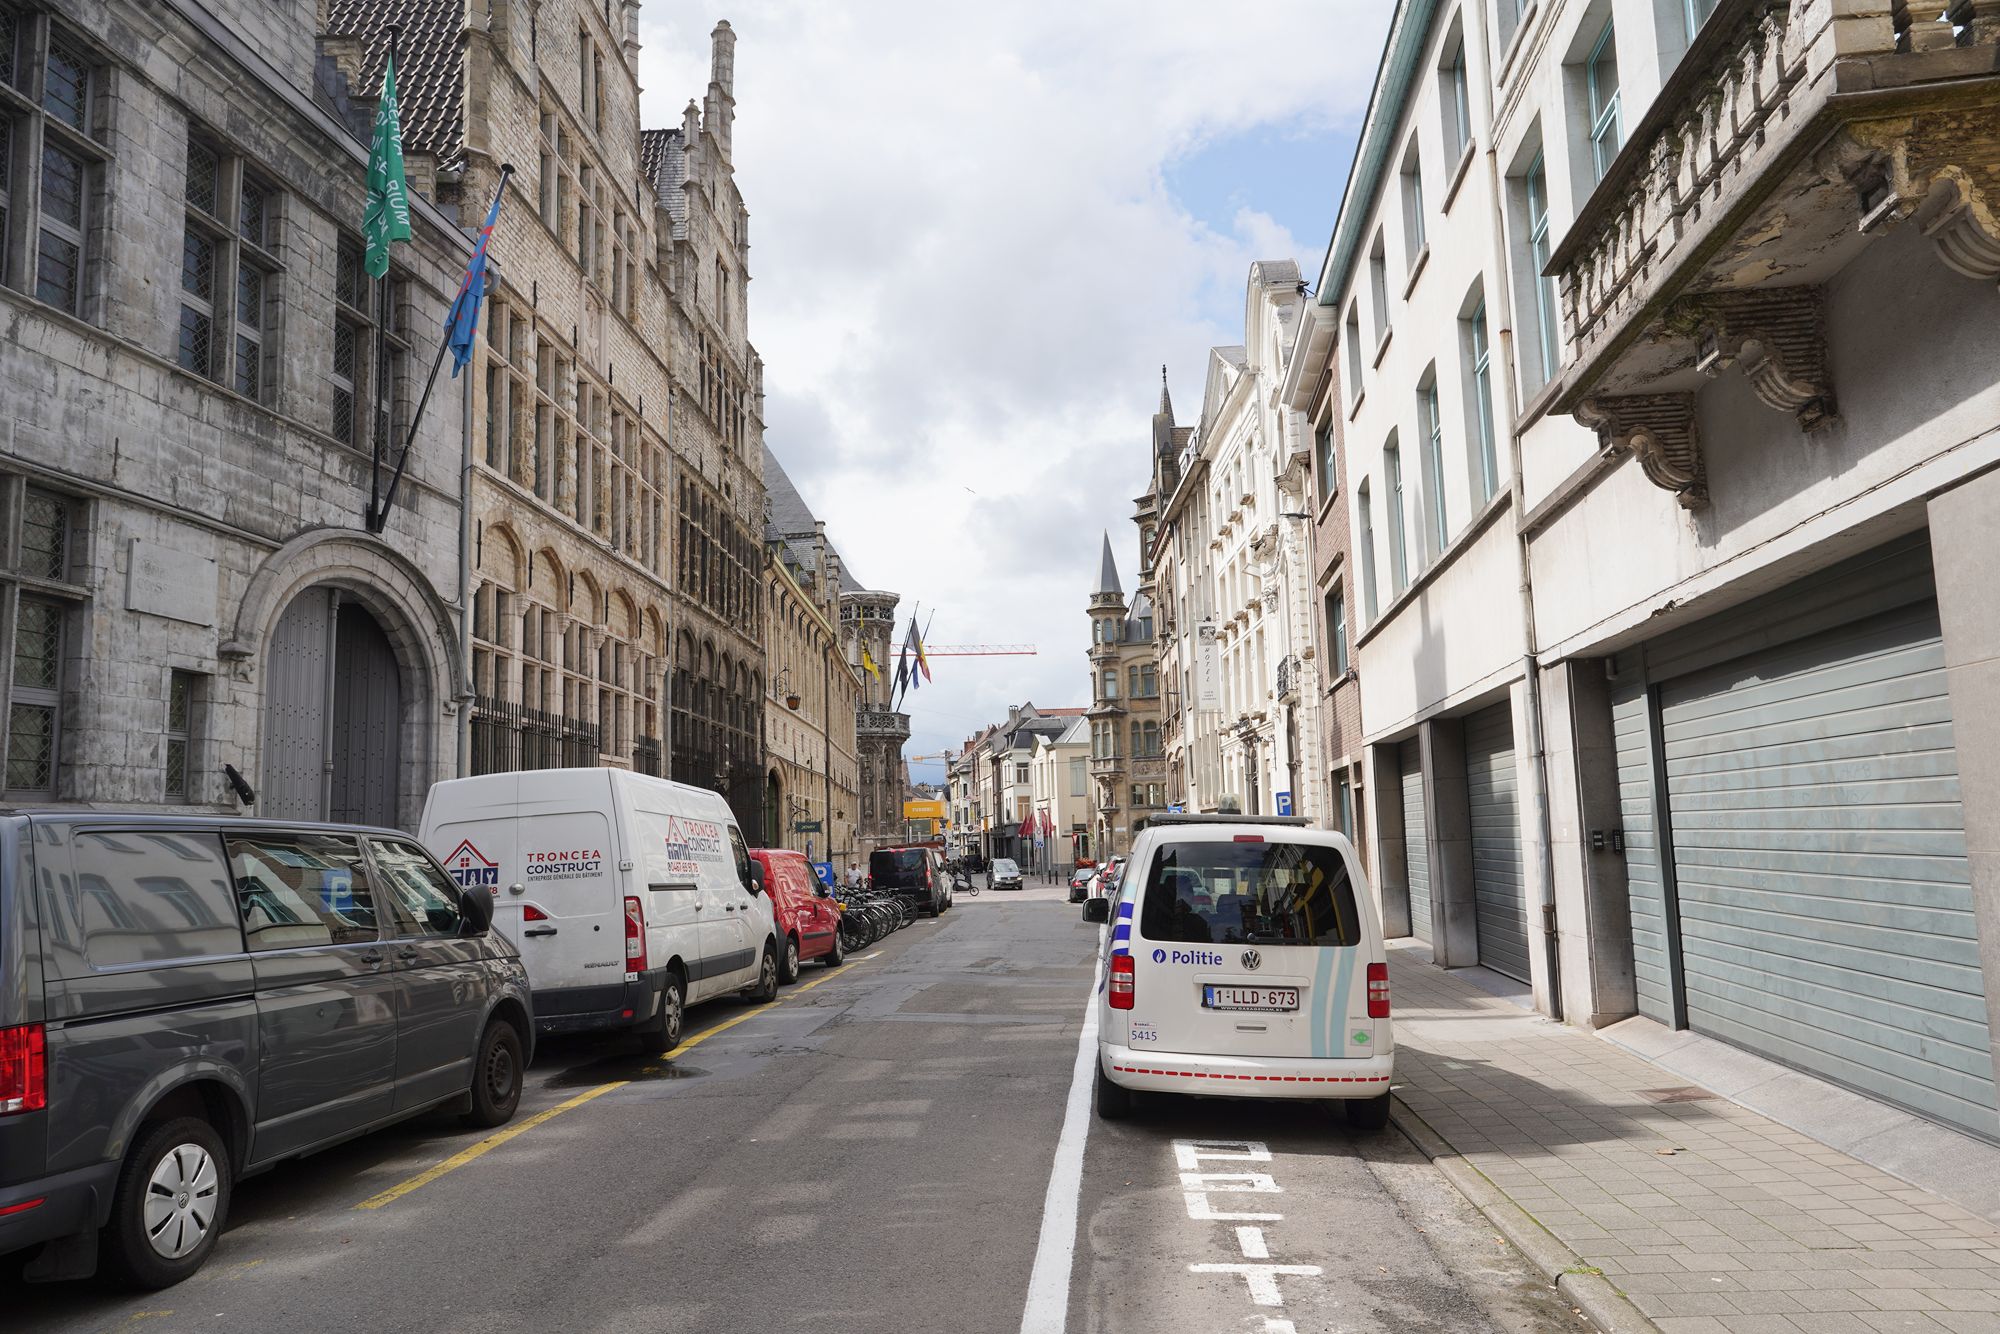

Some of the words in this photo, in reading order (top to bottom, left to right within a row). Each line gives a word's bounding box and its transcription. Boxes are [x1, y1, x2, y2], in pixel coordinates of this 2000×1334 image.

[1278, 795, 1291, 813] P
[684, 820, 720, 839] TRONCEA
[527, 849, 601, 862] TRONCEA
[526, 861, 601, 875] CONSTRUCT
[1172, 950, 1223, 965] Politie
[1131, 1030, 1157, 1042] 5415
